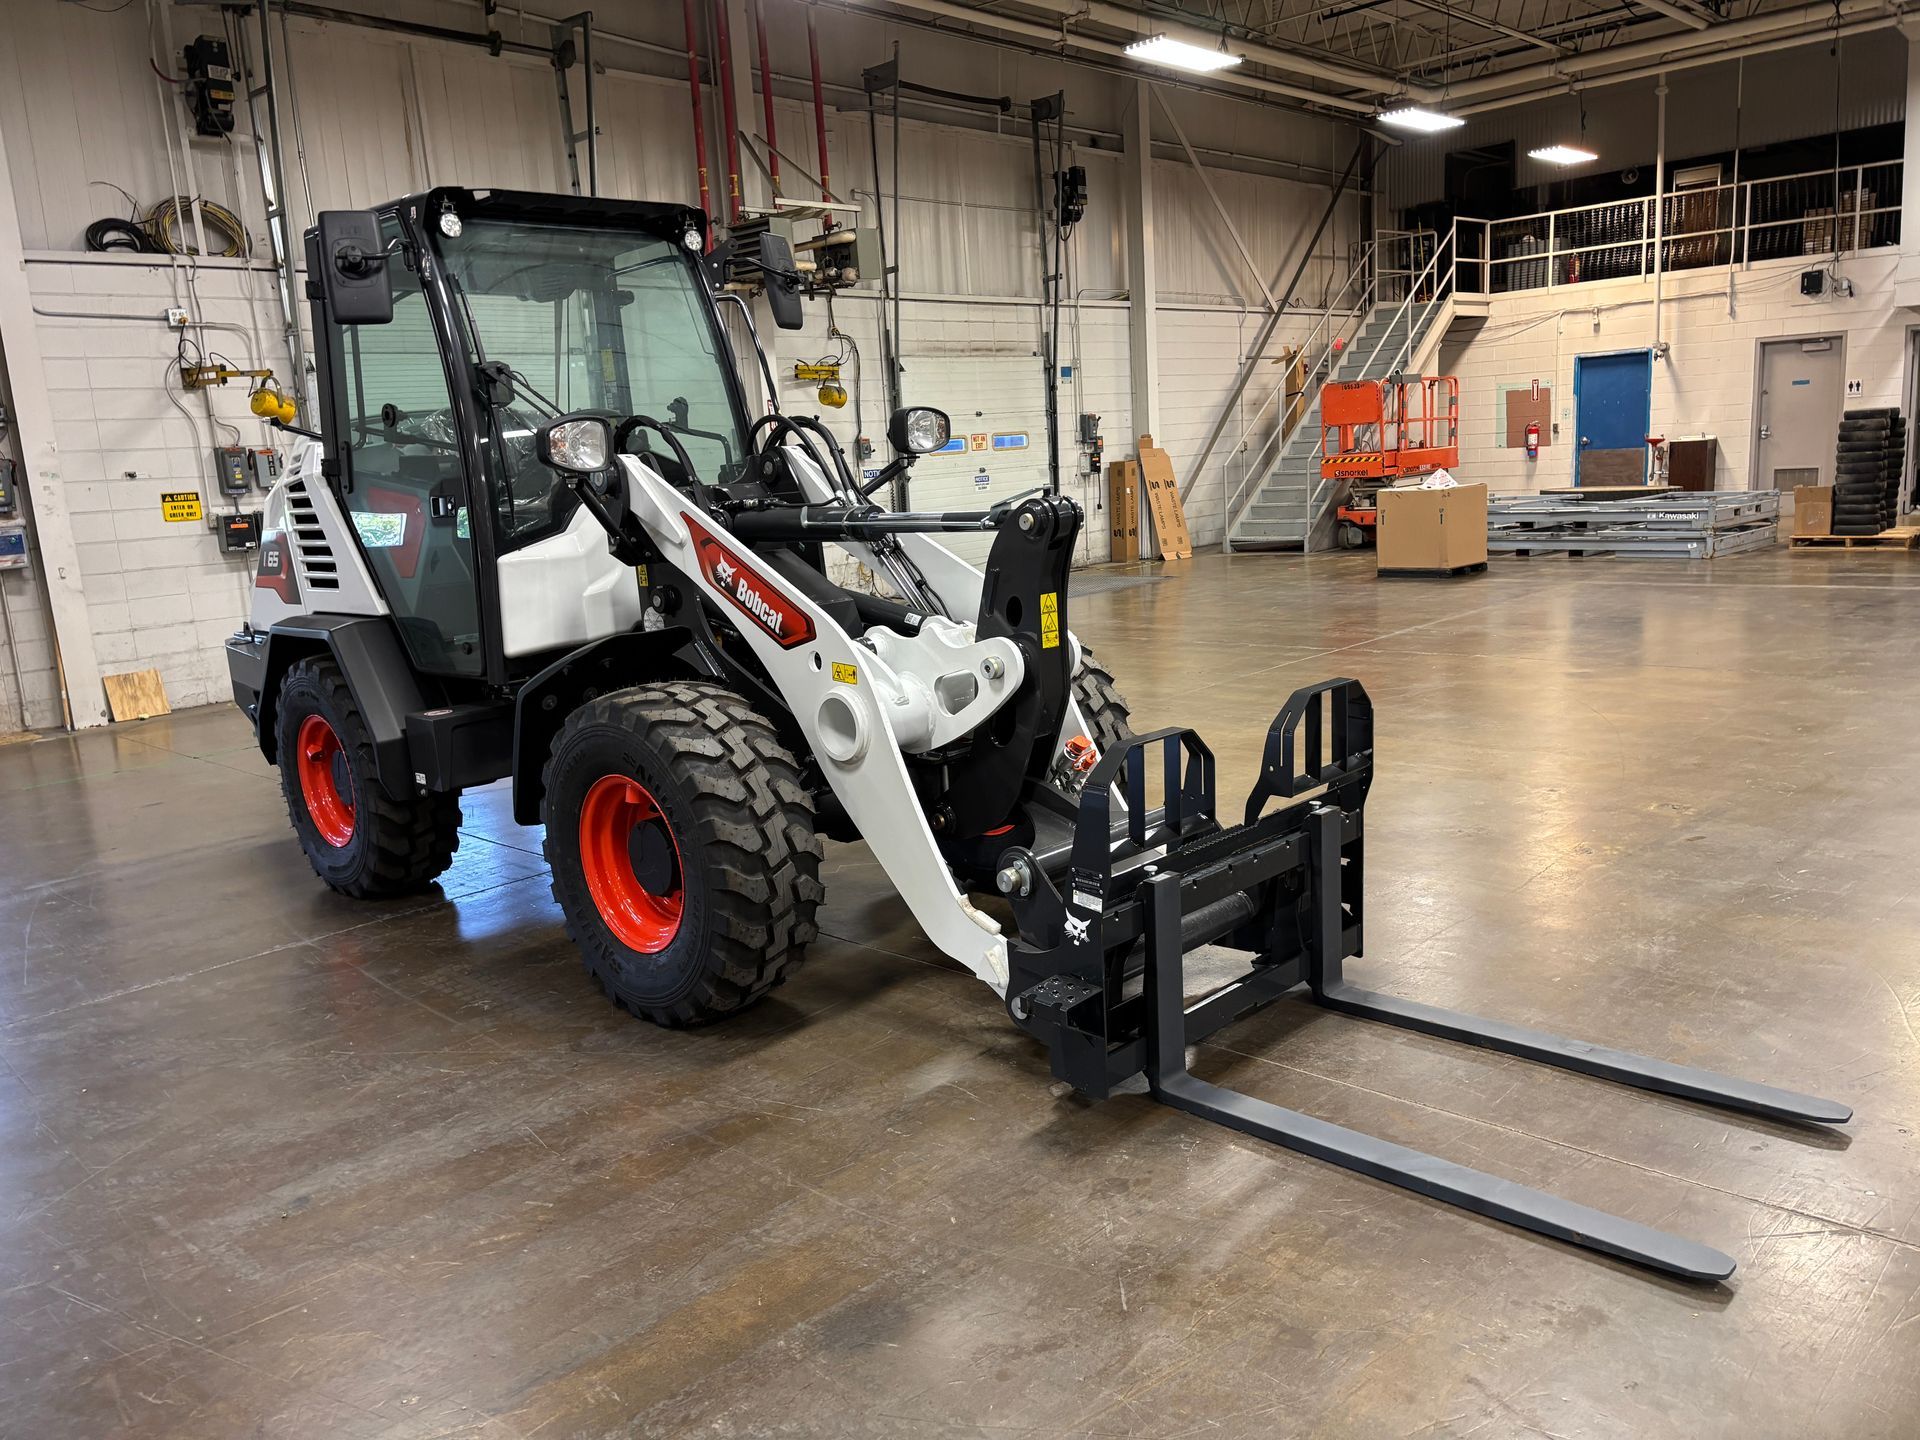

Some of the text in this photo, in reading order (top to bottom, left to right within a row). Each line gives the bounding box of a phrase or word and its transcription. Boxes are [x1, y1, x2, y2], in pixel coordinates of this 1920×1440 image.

[1340, 469, 1368, 477] snorkel
[173, 493, 197, 501] CAUTION
[1174, 509, 1182, 528] LAMPS
[1658, 512, 1699, 520] Kawasaki
[736, 577, 783, 635] Bobcat
